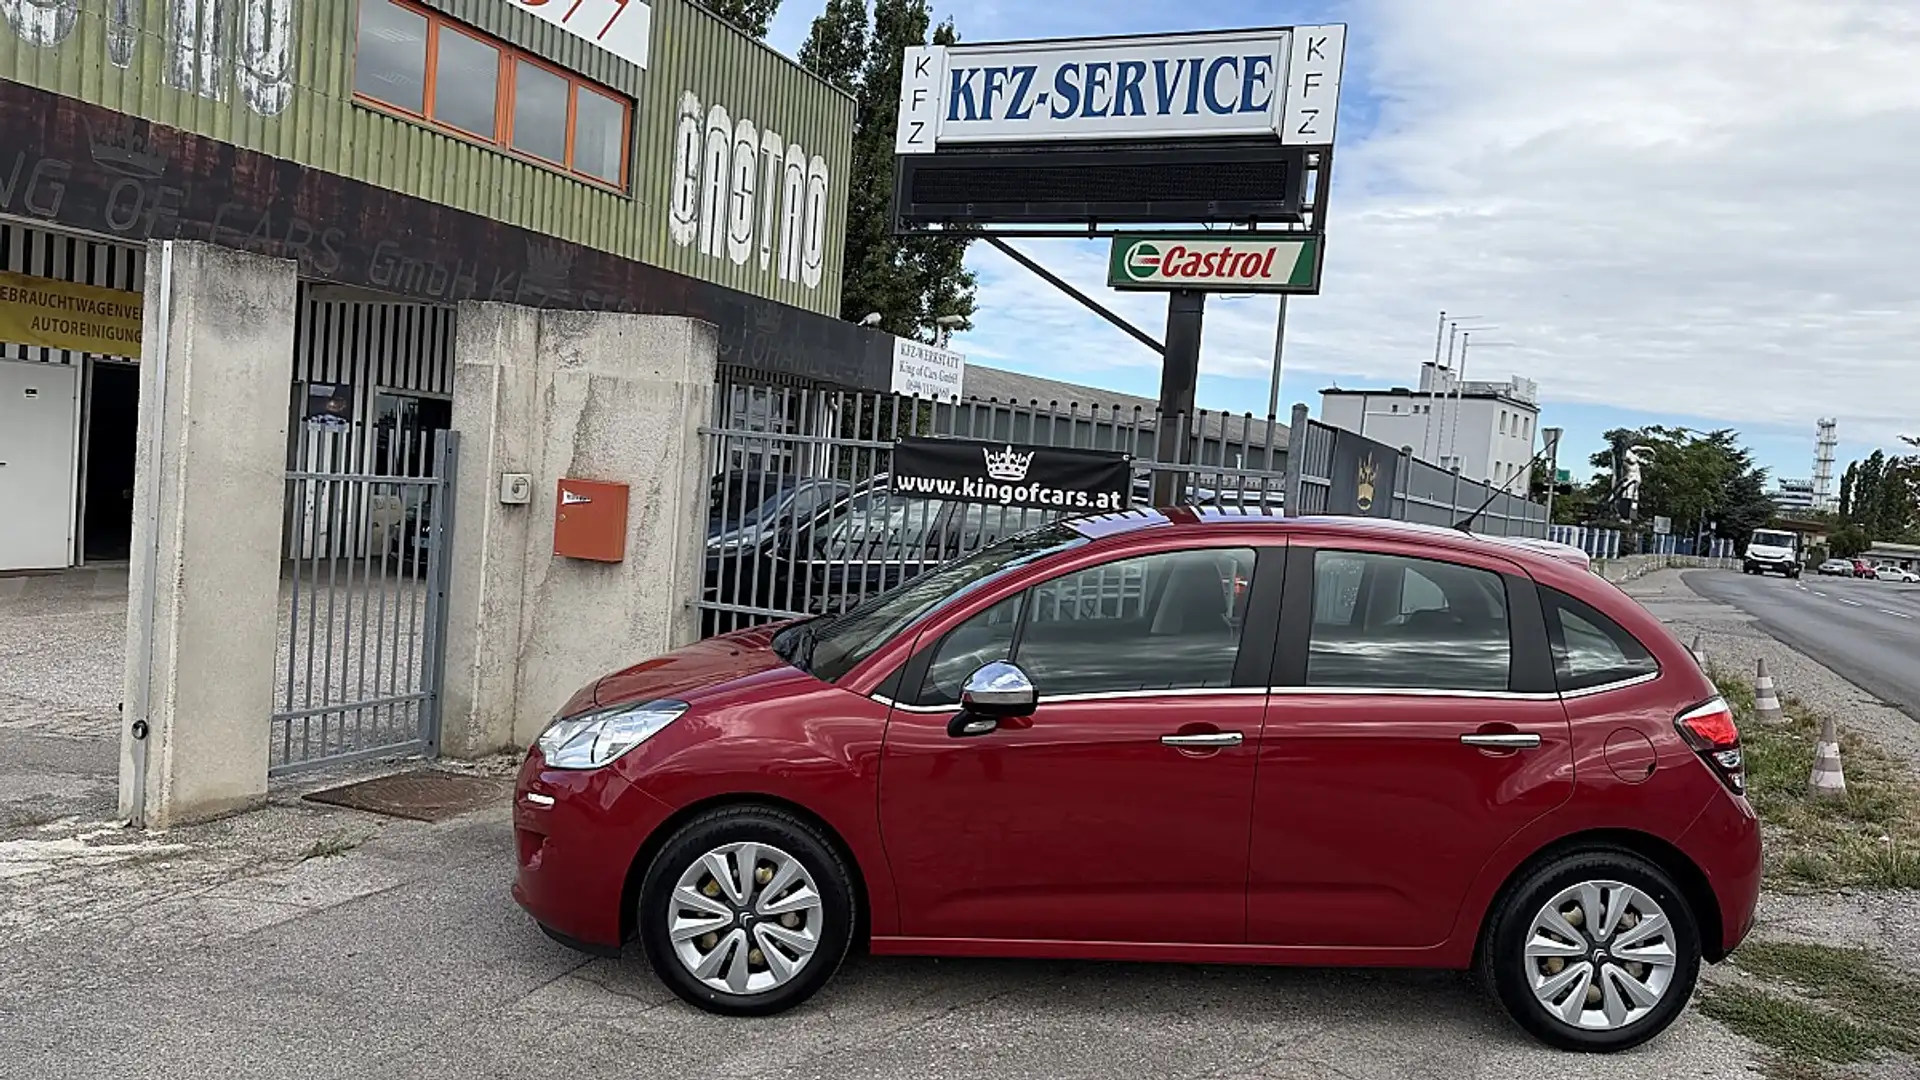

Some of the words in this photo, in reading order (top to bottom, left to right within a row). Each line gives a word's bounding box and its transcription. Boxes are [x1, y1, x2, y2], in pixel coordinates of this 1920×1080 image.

[907, 55, 931, 145] KFZ
[946, 55, 1274, 121] KFZ-SERVICE
[1161, 245, 1278, 279] Castrol
[31, 315, 142, 344] AUTOREINIGUNG
[897, 474, 1122, 510] www.kingofcars.at
